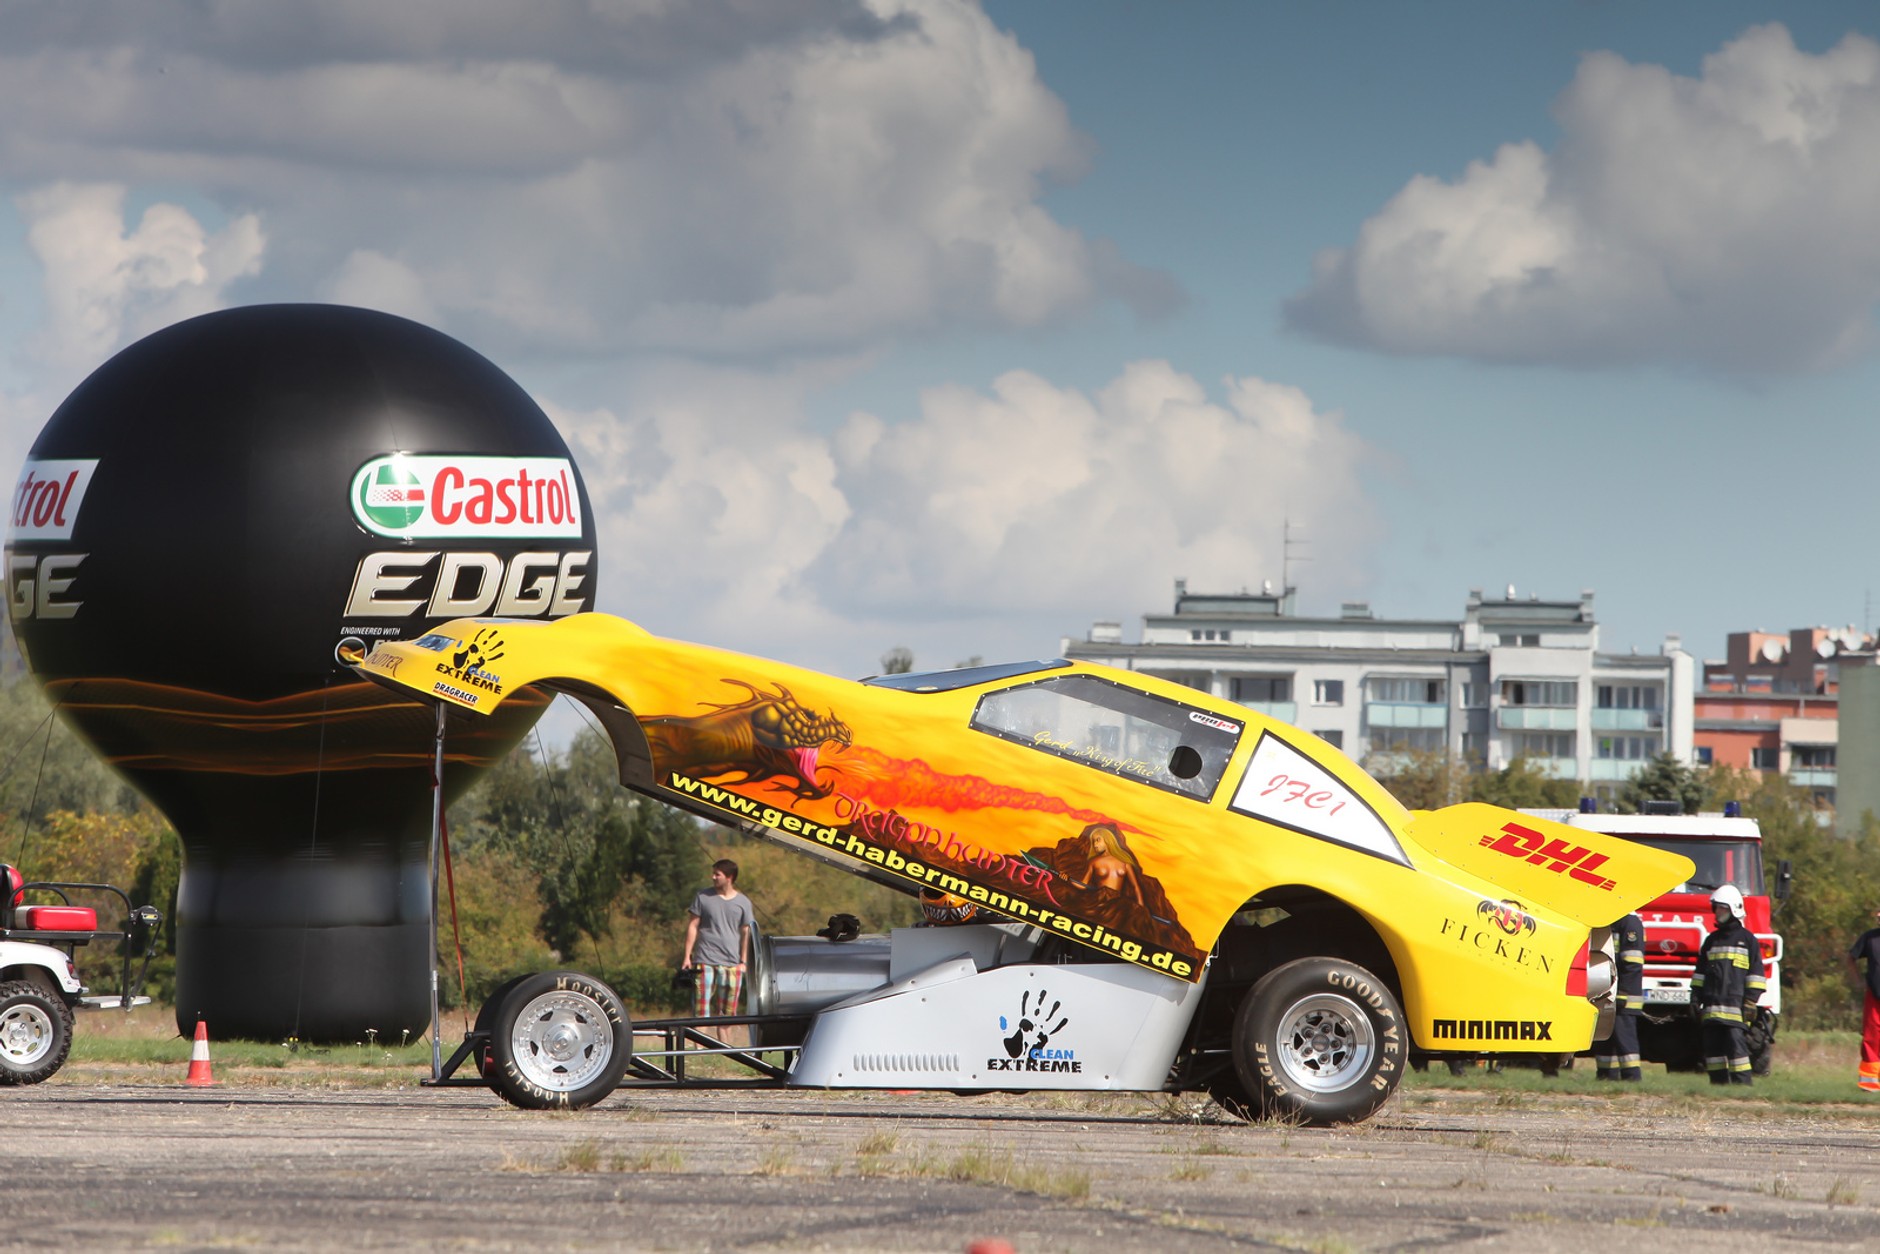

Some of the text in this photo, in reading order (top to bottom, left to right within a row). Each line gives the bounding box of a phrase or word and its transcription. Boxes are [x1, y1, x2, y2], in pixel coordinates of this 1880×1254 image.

[10, 469, 80, 528] trol
[431, 466, 576, 526] Castrol
[8, 552, 91, 620] GE
[342, 550, 593, 618] EDGE
[340, 626, 401, 636] ENGINEERED WITH
[433, 681, 479, 704] DRAGRACER
[435, 662, 503, 695] EXTREME
[467, 664, 501, 684] CLEAN
[1033, 730, 1074, 750] Gerd
[1113, 757, 1133, 772] of
[671, 771, 1193, 977] www.gerd-habermann-racing.de
[1486, 821, 1612, 888] DHL
[1636, 913, 1705, 923] TAR
[1440, 917, 1555, 974] FICKEN
[1029, 1048, 1075, 1060] CLEAN
[1326, 969, 1400, 1091] GOODYEAR
[1432, 1018, 1553, 1041] MINIMAX
[986, 1058, 1083, 1074] EXTREME
[1254, 1041, 1289, 1098] EAGLE
